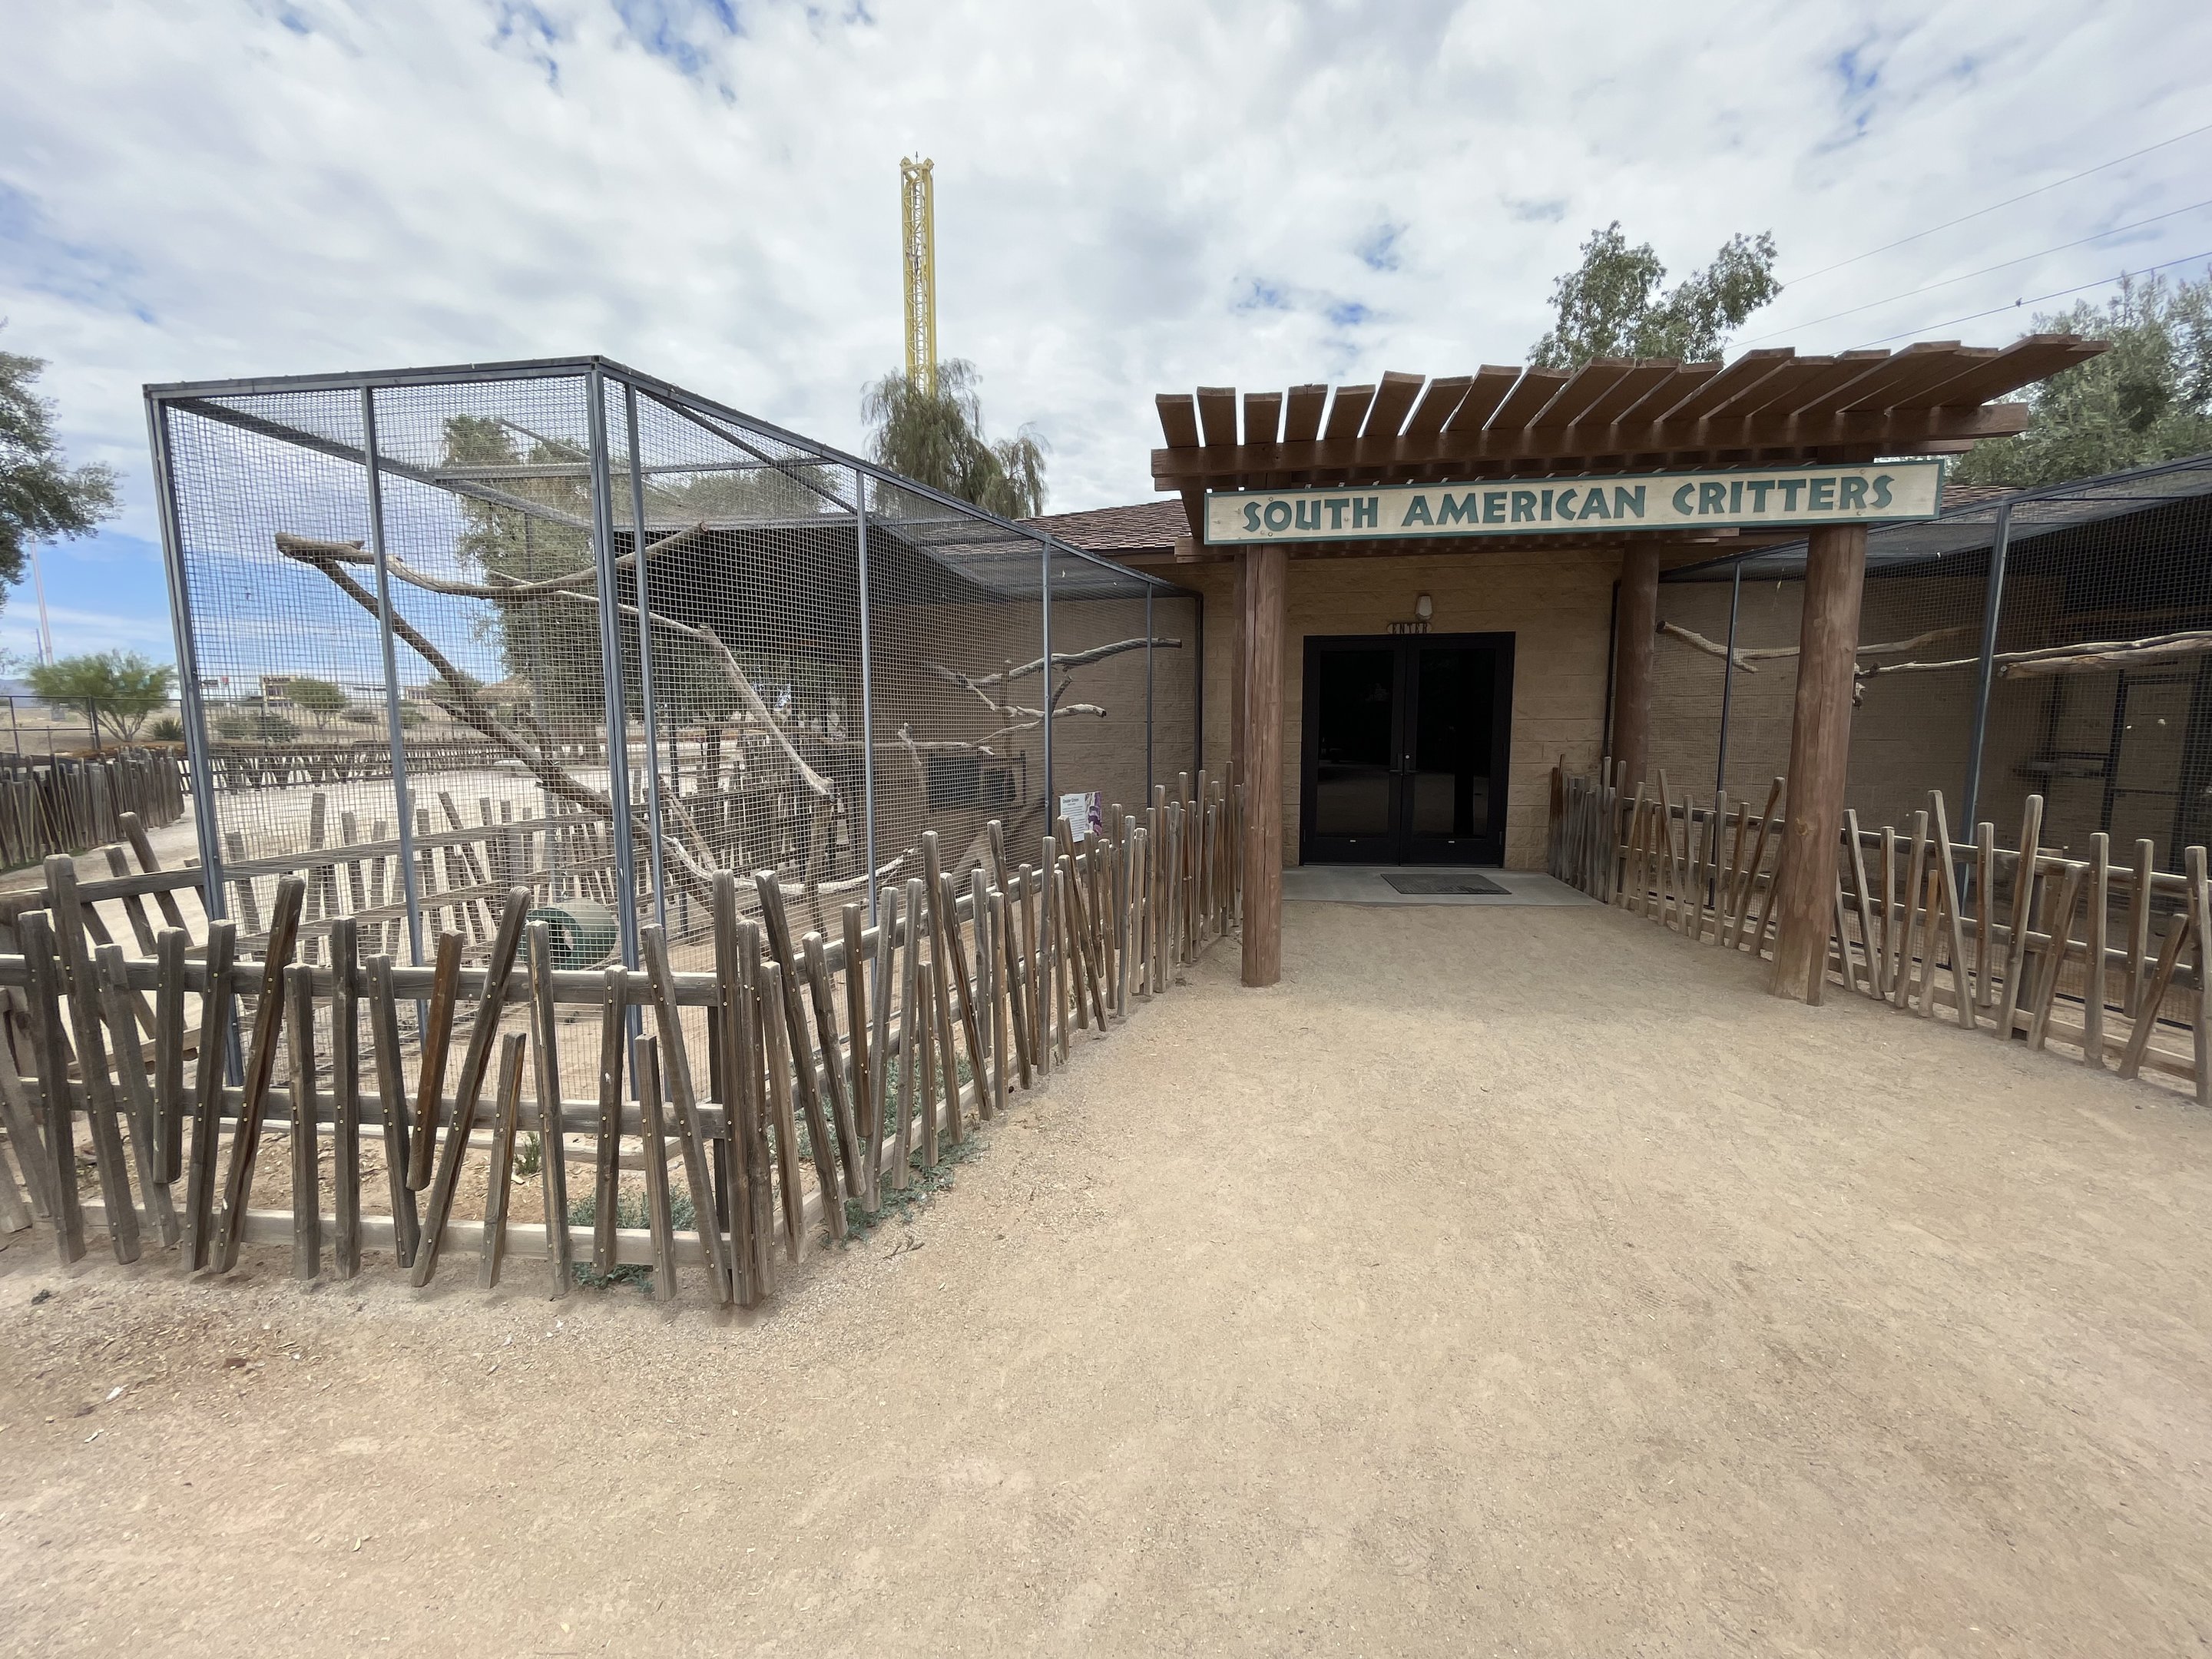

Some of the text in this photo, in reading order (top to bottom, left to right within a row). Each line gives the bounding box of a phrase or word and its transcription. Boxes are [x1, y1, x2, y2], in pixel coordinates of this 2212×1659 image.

[1243, 475, 1895, 532] SOUTH AMERICAN CRITTERS
